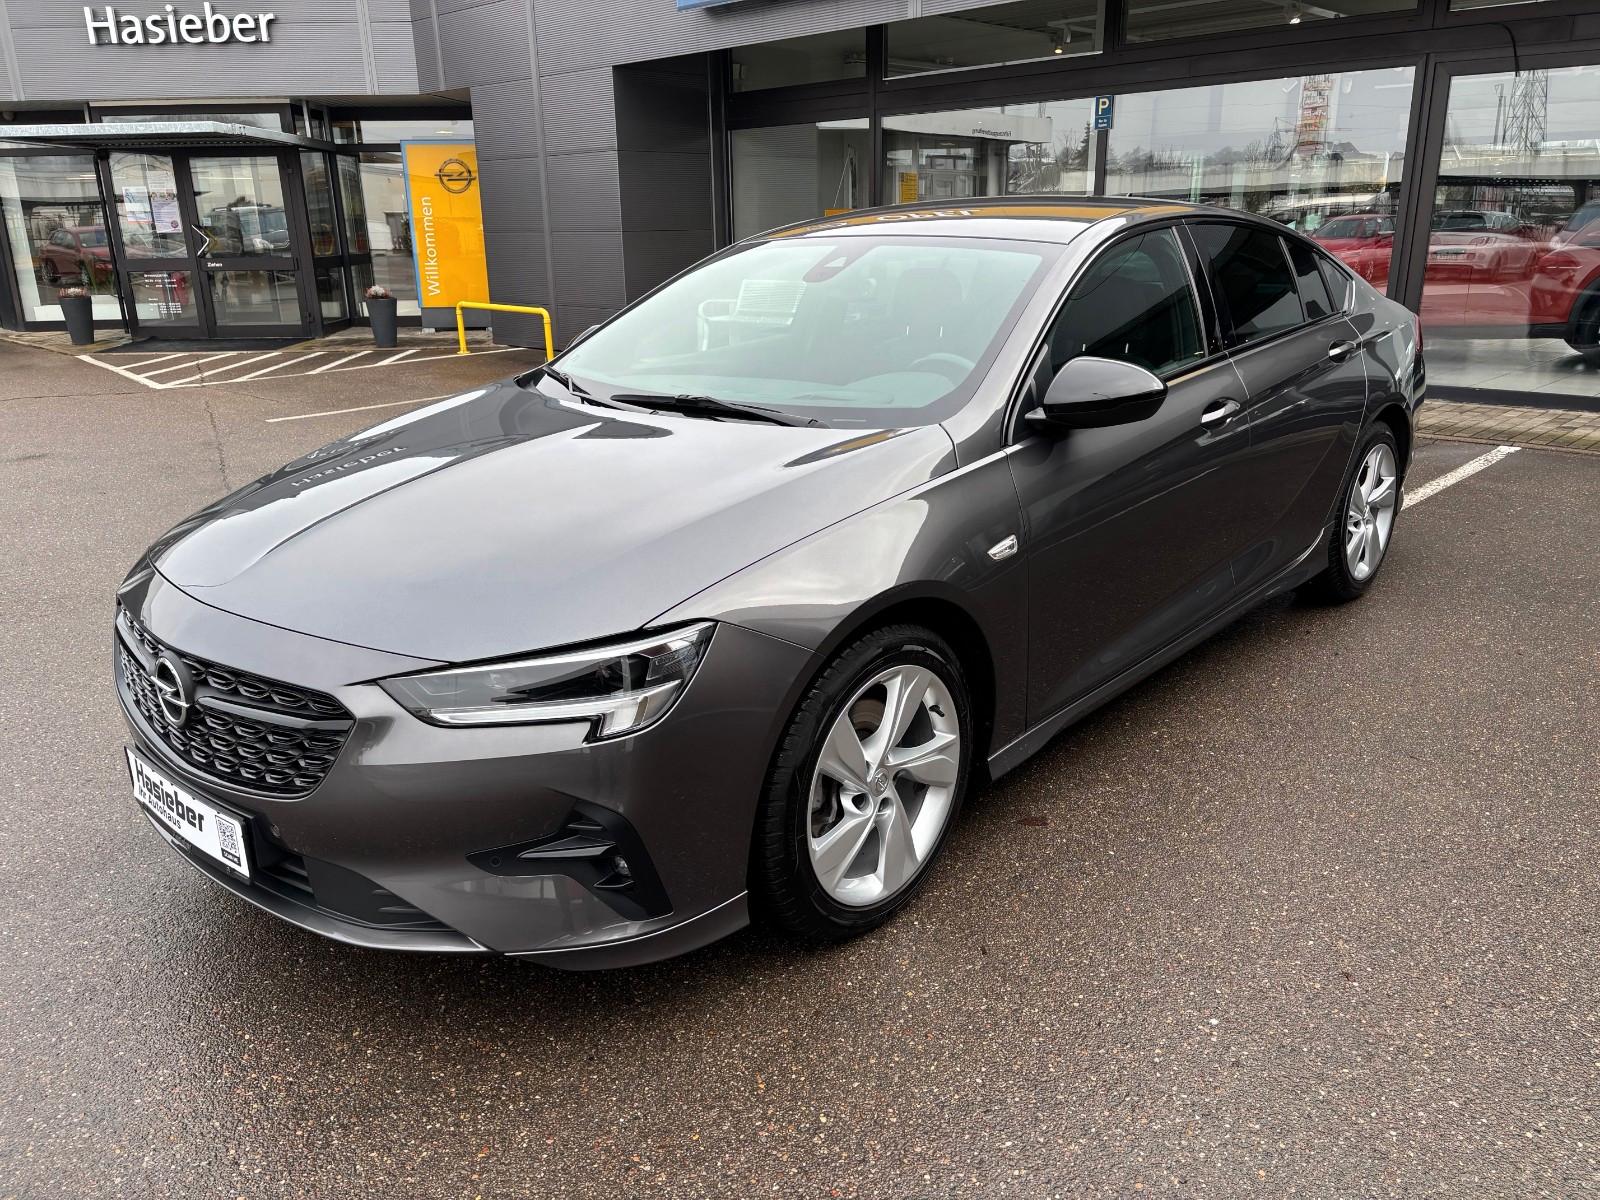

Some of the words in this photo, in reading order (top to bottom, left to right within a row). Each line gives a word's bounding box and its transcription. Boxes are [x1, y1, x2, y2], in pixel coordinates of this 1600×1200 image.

[84, 2, 275, 44] Hasieber
[1098, 98, 1109, 114] P
[421, 197, 440, 296] Willkommen
[135, 759, 205, 832] Hasieber
[148, 795, 182, 830] Autohaus
